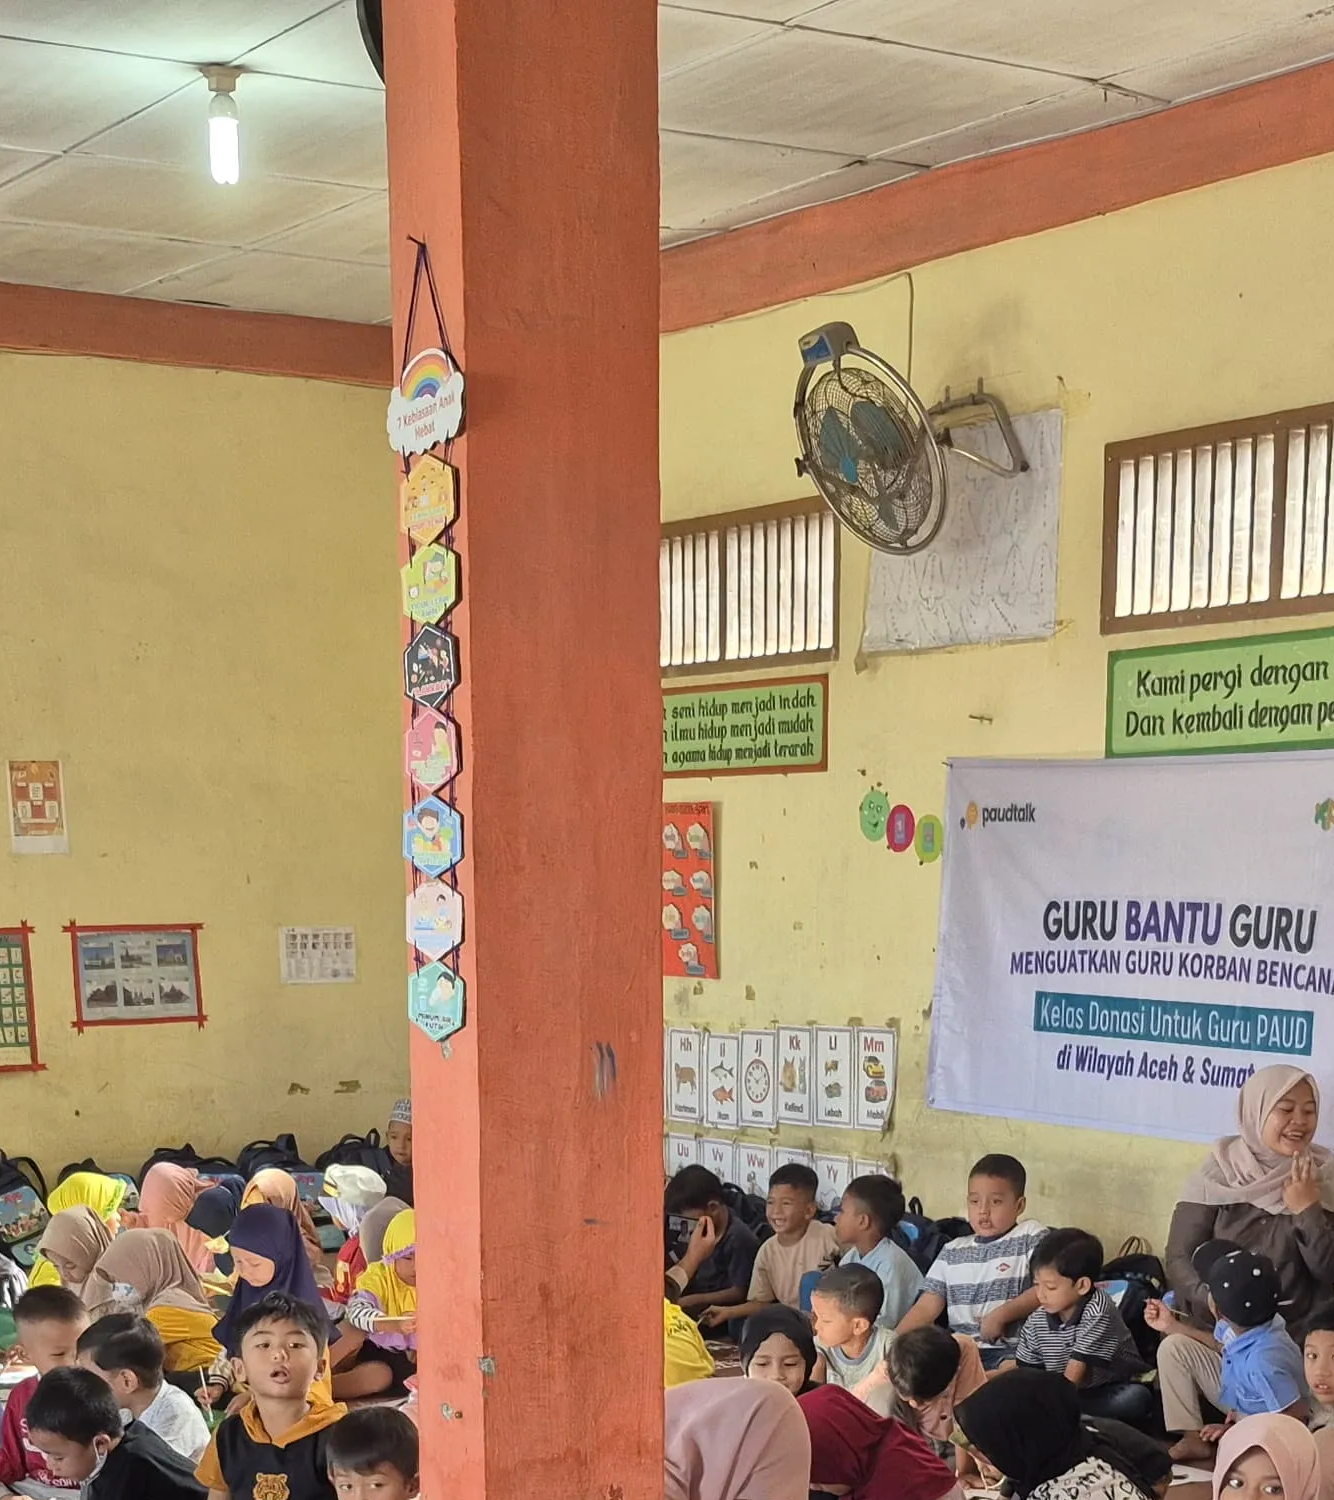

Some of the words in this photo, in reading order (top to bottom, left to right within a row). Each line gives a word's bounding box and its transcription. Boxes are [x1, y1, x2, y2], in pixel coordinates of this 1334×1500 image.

[1137, 669, 1185, 699] Kami
[1190, 664, 1242, 701] pergi
[1251, 655, 1329, 694] dengan
[672, 702, 695, 719] seni
[698, 697, 728, 721] hidup
[732, 691, 776, 719] menjadi
[1126, 710, 1165, 737] Dan
[1172, 703, 1243, 735] kembali
[1249, 700, 1313, 733] dengan
[671, 721, 696, 742] ilmu
[698, 719, 727, 743] hidup
[731, 715, 775, 742] menjadi
[778, 712, 814, 734] mudah
[672, 750, 706, 768] agama
[708, 743, 733, 765] hidup
[735, 740, 772, 764] menjadi
[774, 736, 814, 758] terarah
[982, 802, 1035, 828] paudtalk
[1043, 900, 1118, 941] GURU
[1125, 900, 1222, 946] BANTU
[1230, 904, 1318, 954] GURU
[1010, 949, 1121, 975] MENGUATKAN
[1126, 950, 1173, 976] GURU
[1179, 954, 1251, 984] KORBAN
[1040, 998, 1084, 1030] Kelas
[1089, 1001, 1145, 1035] Donasi
[1150, 1008, 1202, 1041] Untuk
[1208, 1012, 1250, 1045] Guru
[1256, 1015, 1308, 1049] PAUD
[789, 1036, 801, 1050] Kk
[864, 1037, 884, 1052] Mm
[1057, 1045, 1071, 1070] di
[1075, 1046, 1134, 1081] Wilayah
[1137, 1051, 1177, 1082] Aceh
[1183, 1060, 1194, 1084] &
[1200, 1057, 1255, 1089] Sumat
[747, 1154, 765, 1169] Ww
[827, 1165, 838, 1182] Yy
